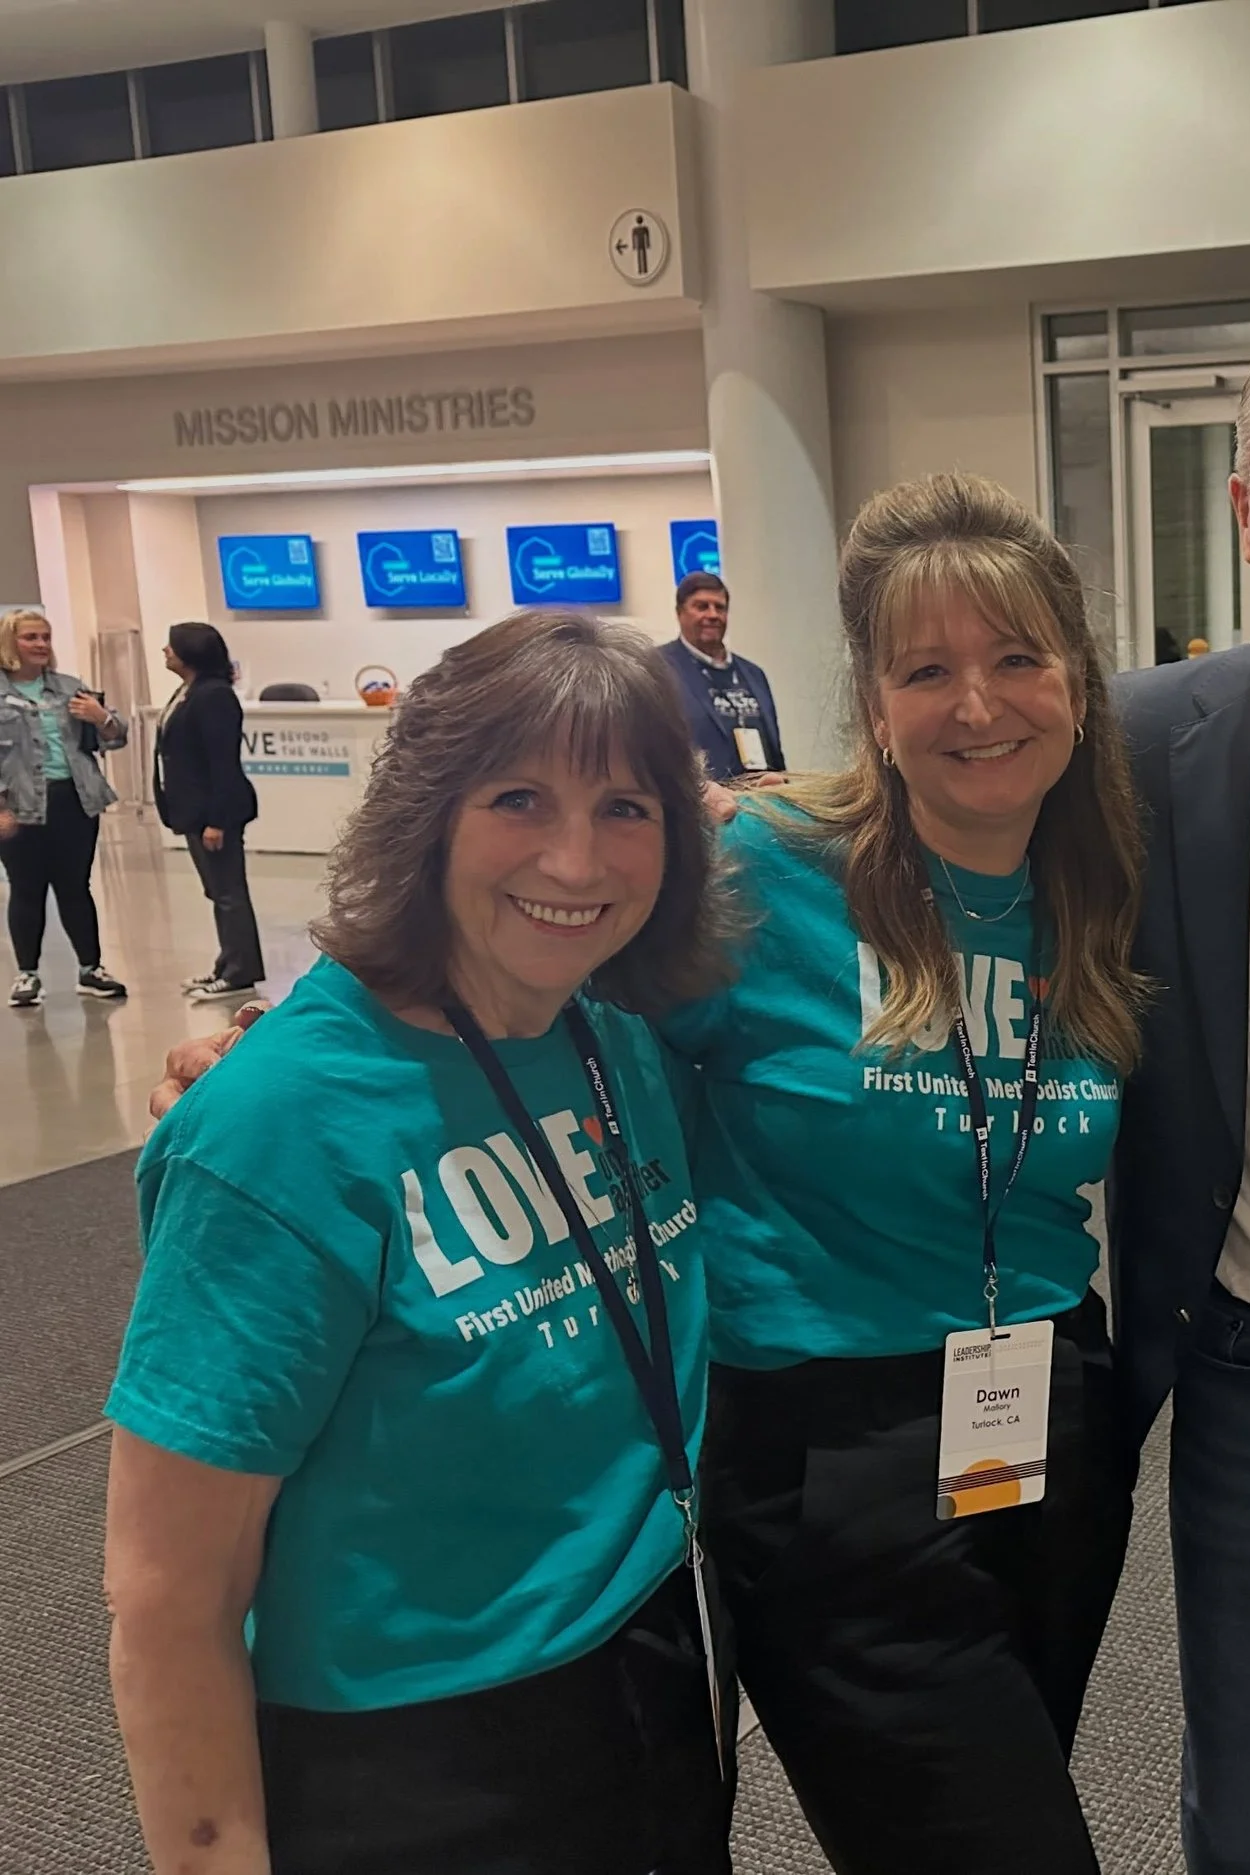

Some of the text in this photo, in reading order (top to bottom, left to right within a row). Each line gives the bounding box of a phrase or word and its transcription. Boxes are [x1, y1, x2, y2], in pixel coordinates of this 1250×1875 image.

[173, 386, 536, 447] MISSION MINISTRIES
[388, 571, 417, 584] Serve
[533, 567, 564, 581] Serve
[241, 731, 276, 755] VE
[281, 731, 328, 743] BEYOND
[282, 745, 349, 758] THE WALLS
[857, 941, 1028, 1060] LVE
[863, 1066, 914, 1093] First
[917, 1071, 969, 1097] Unite
[985, 1077, 1079, 1101] Metodist
[401, 1109, 616, 1298] LOVE
[455, 1299, 518, 1342] First
[514, 1266, 576, 1316] United
[953, 1344, 992, 1357] LEADERSHIP
[976, 1387, 1020, 1403] Dawn
[983, 1403, 1011, 1412] Mallory
[1007, 1415, 1021, 1424] CA
